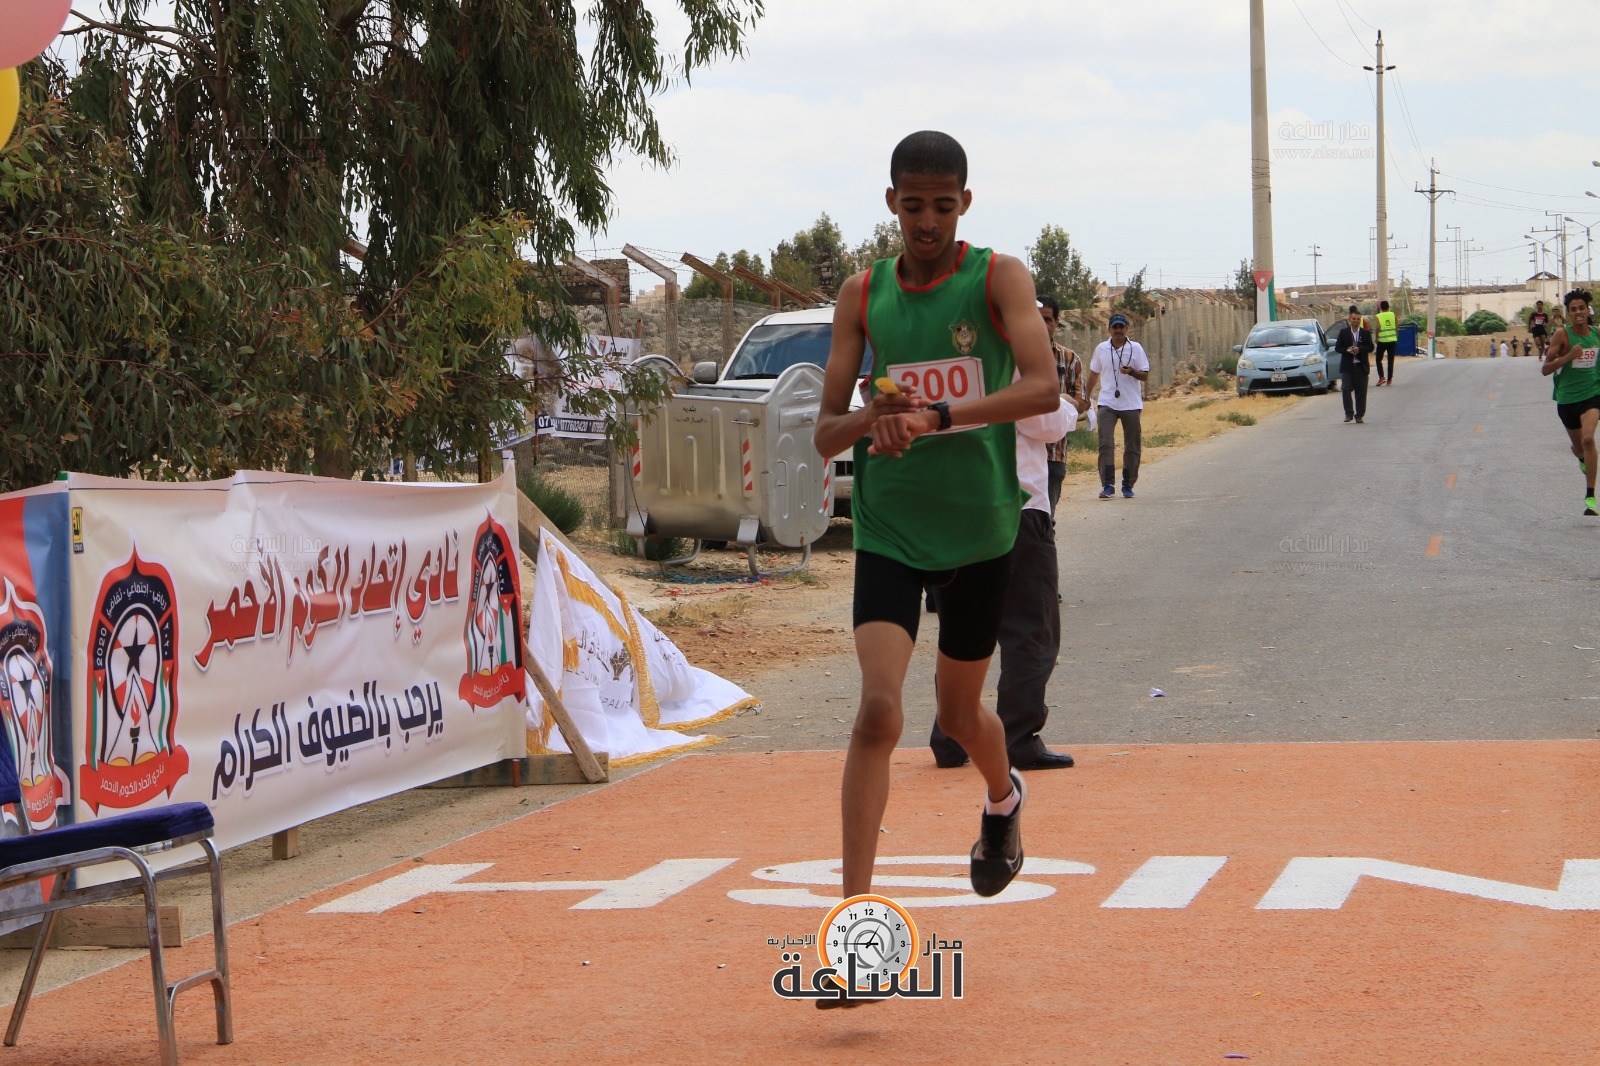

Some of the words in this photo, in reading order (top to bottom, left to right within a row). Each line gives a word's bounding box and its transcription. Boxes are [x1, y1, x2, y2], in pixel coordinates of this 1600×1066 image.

[901, 365, 969, 401] 200
[106, 587, 123, 618] ثقافي
[152, 591, 167, 611] رياضي
[194, 538, 286, 668] الأحمر
[288, 544, 350, 660] الكوم
[406, 528, 459, 641] نادي
[96, 627, 107, 667] 2020
[297, 679, 391, 767] بالضيوف
[393, 681, 444, 744] يرحب
[151, 761, 165, 787] نادي
[211, 701, 292, 801] الكرام
[119, 780, 138, 798] الكوم
